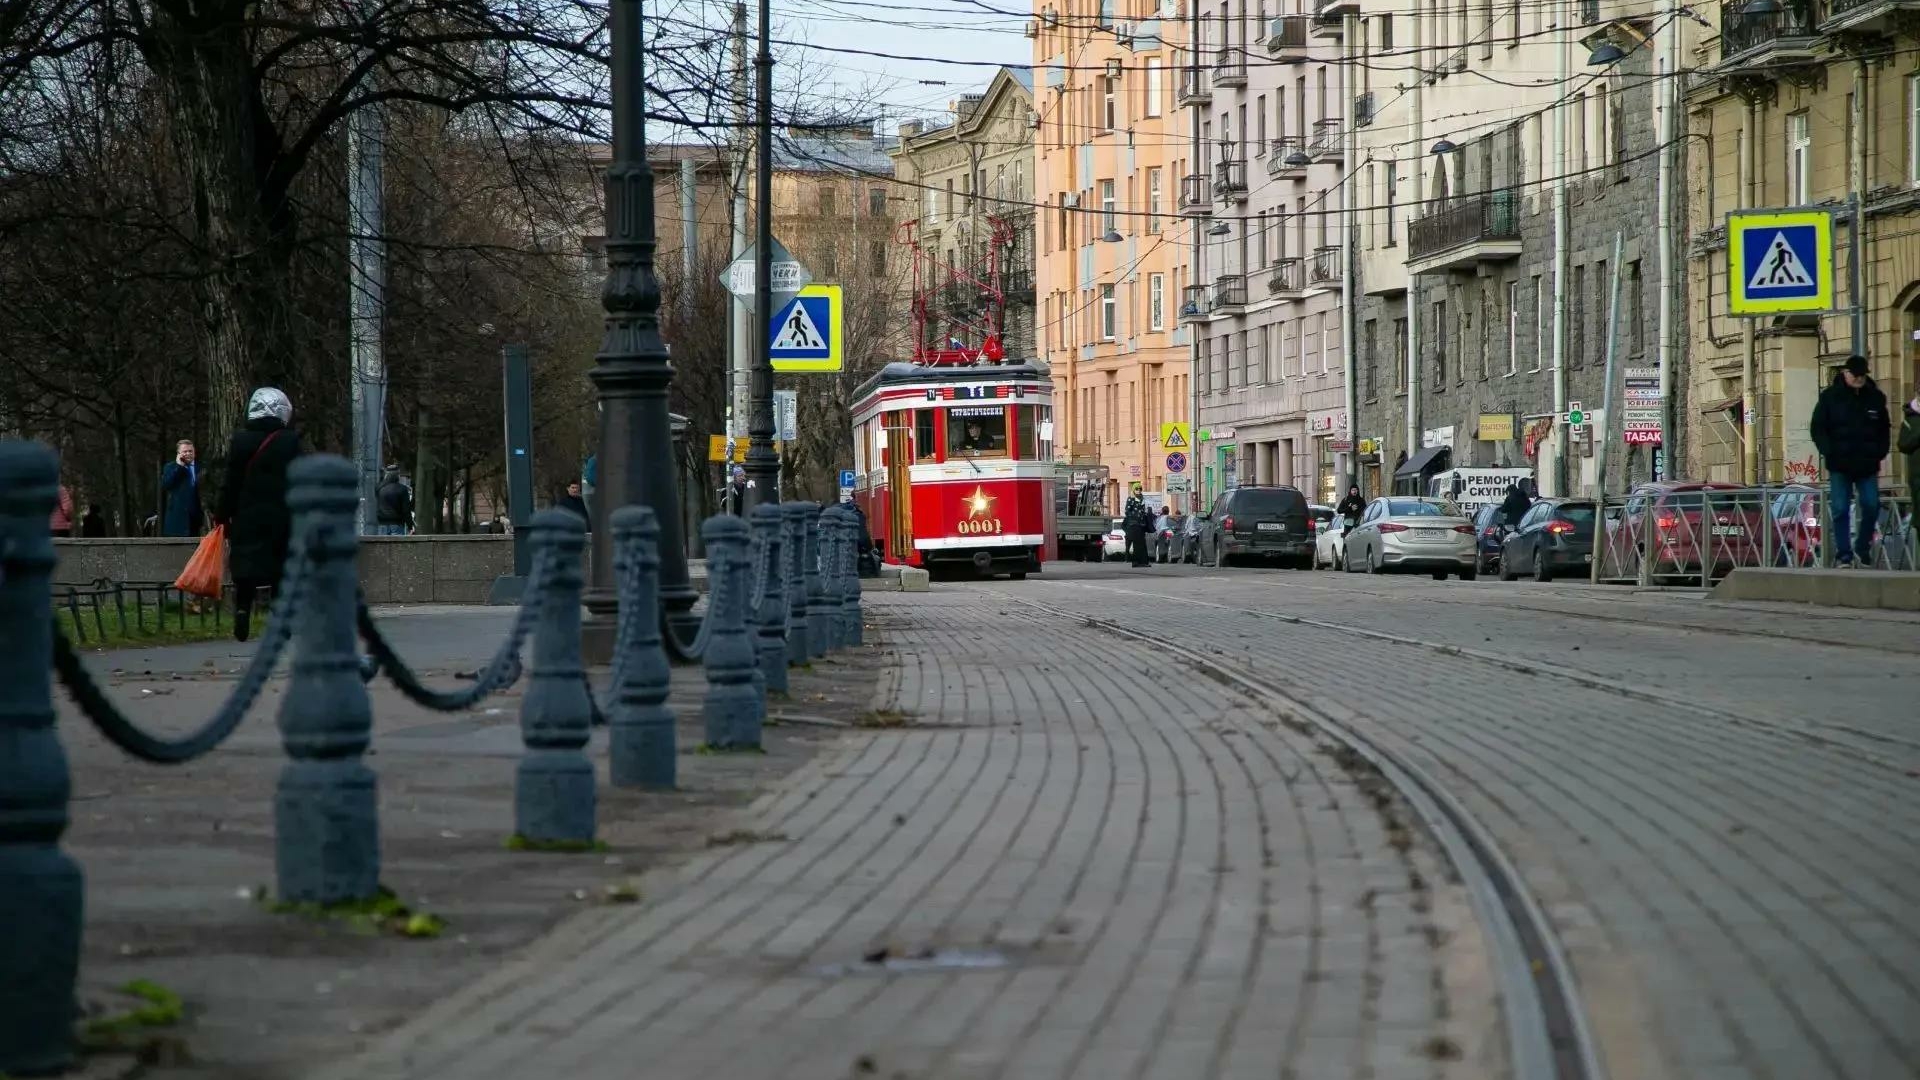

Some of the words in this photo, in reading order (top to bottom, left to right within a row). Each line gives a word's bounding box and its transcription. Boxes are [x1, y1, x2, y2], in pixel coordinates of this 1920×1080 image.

[773, 269, 798, 278] ЧЕКИ
[1624, 432, 1662, 442] ТАБАК
[1467, 476, 1520, 485] РЕМОНТ
[1469, 487, 1509, 497] СКУПК
[957, 518, 1002, 534] 0001
